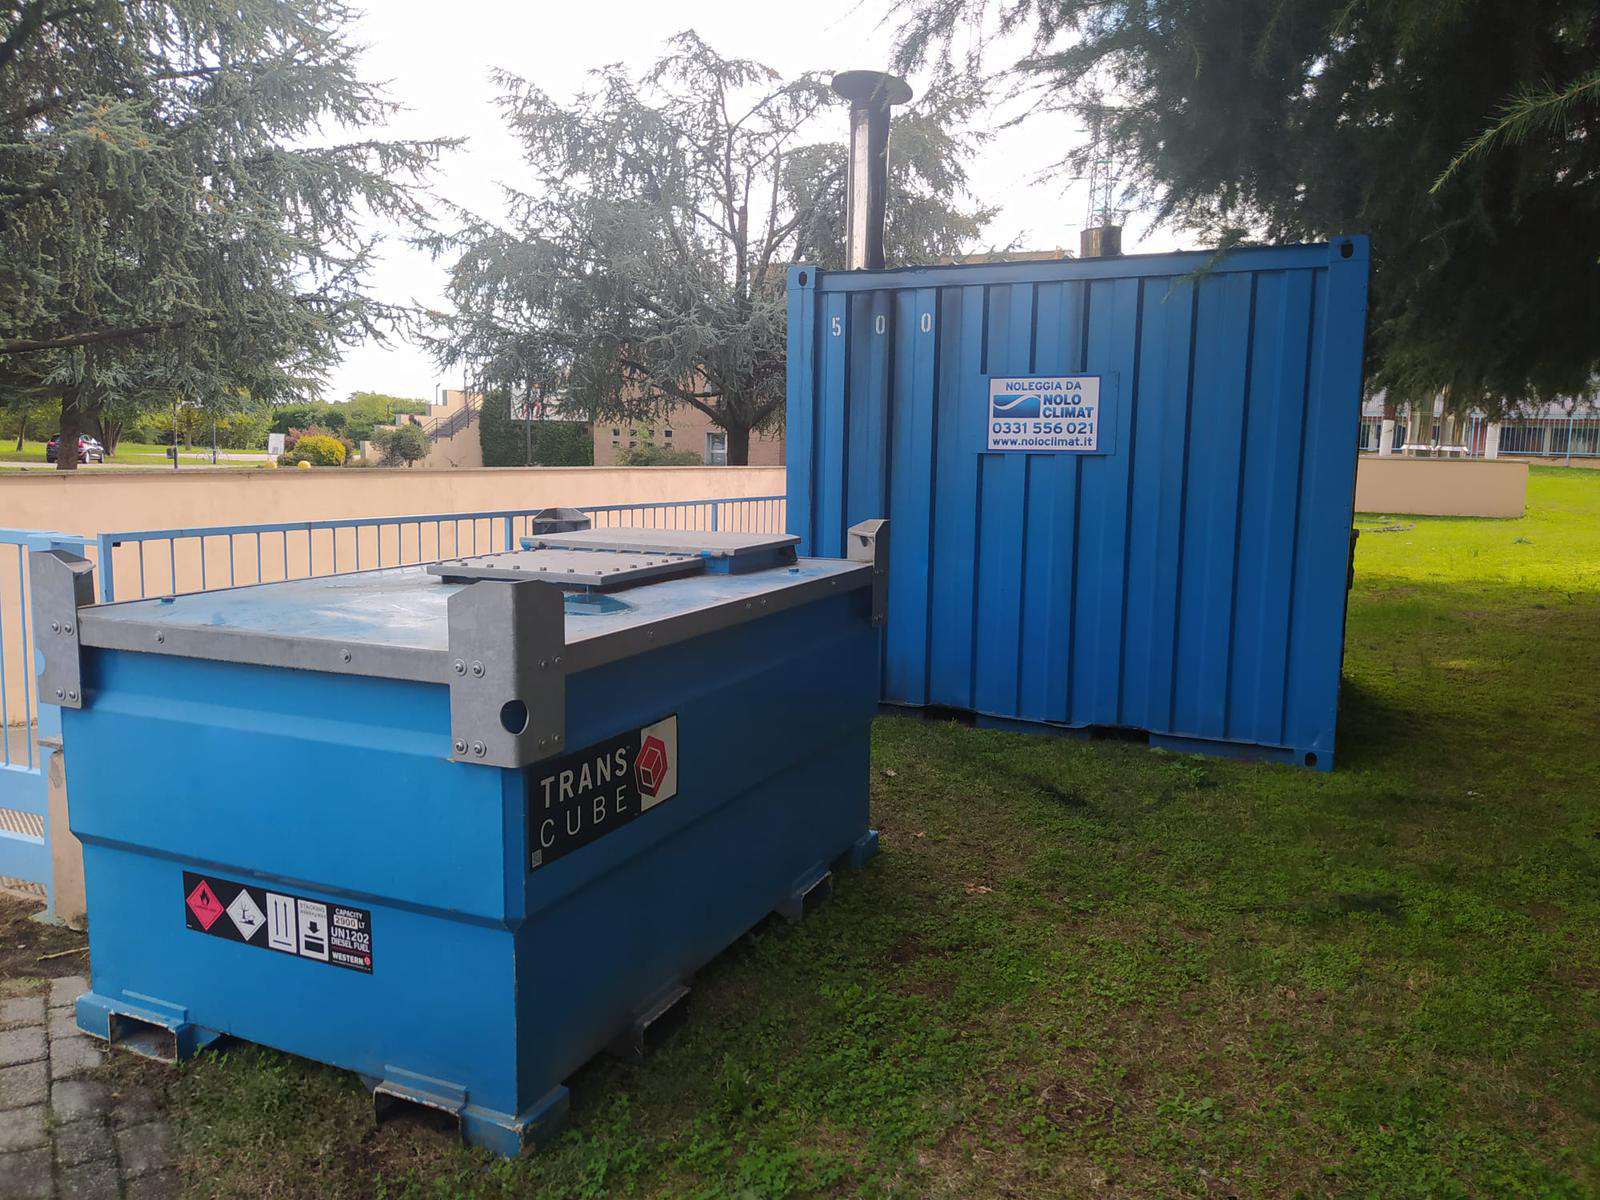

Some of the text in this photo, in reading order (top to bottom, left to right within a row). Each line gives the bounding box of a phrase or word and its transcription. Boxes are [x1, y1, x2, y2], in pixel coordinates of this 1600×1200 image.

[1006, 381, 1082, 391] NOLEGGIA DA
[1043, 394, 1082, 405] NOLO
[1042, 406, 1094, 418] CLIMAT
[992, 422, 1094, 434] 0331 556 021
[992, 436, 1093, 447] www.noloclimat.it
[540, 747, 628, 809] TRANS
[540, 785, 628, 847] CUBE
[335, 908, 363, 919] CAPACITY
[335, 916, 366, 929] 2900 LT
[331, 926, 370, 944] UN1202
[331, 936, 371, 953] DIESEL FUEL
[332, 951, 364, 965] WESTERN
